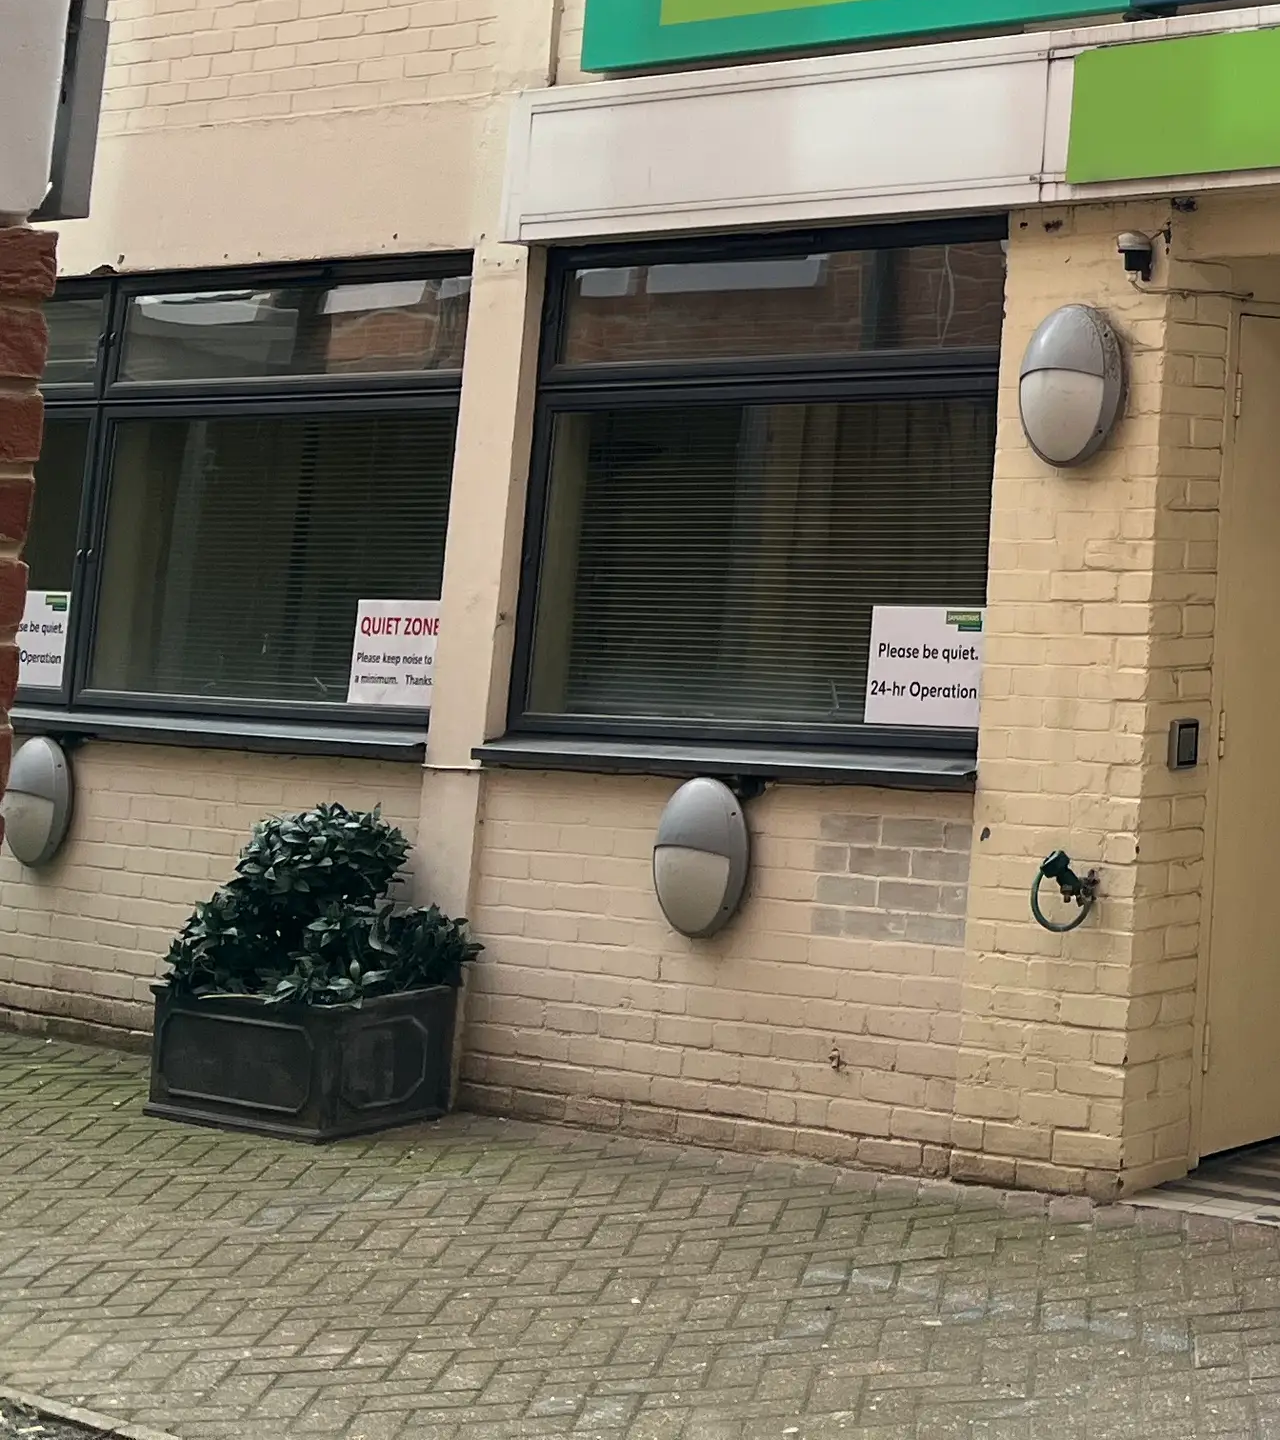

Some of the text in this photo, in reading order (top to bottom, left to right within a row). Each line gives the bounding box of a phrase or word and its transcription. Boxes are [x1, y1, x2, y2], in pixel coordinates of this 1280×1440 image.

[29, 620, 40, 632] be
[41, 621, 64, 636] quiet.
[361, 616, 402, 637] QUIET
[20, 649, 62, 666] Operation
[356, 652, 432, 666] Please keep noise to
[878, 642, 979, 663] Please be quiet.
[360, 673, 398, 684] minimum.
[871, 680, 977, 702] 24-hr Operation
